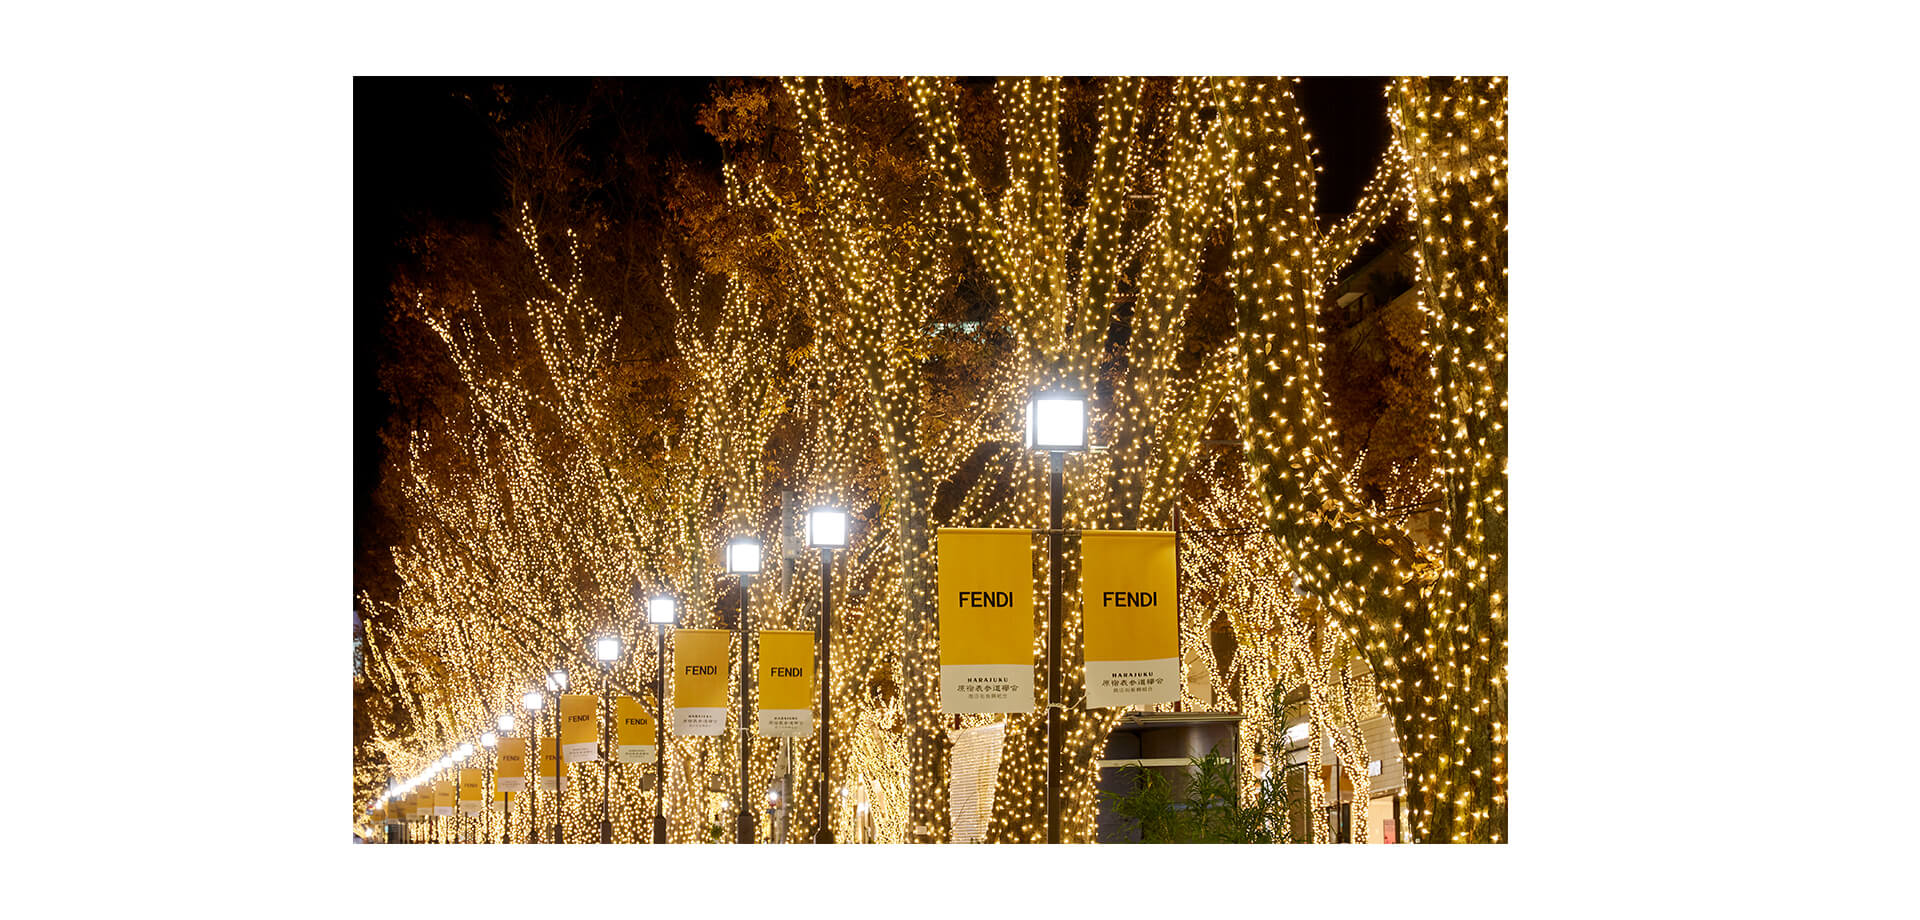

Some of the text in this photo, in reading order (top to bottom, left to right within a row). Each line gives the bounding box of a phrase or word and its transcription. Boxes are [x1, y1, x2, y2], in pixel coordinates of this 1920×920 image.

[959, 591, 1013, 608] FENDI
[1103, 591, 1157, 608] FENDI
[685, 665, 717, 676] FENDI
[771, 667, 803, 677] FENDI
[568, 714, 590, 723] FENDI
[625, 718, 648, 726] FENDI
